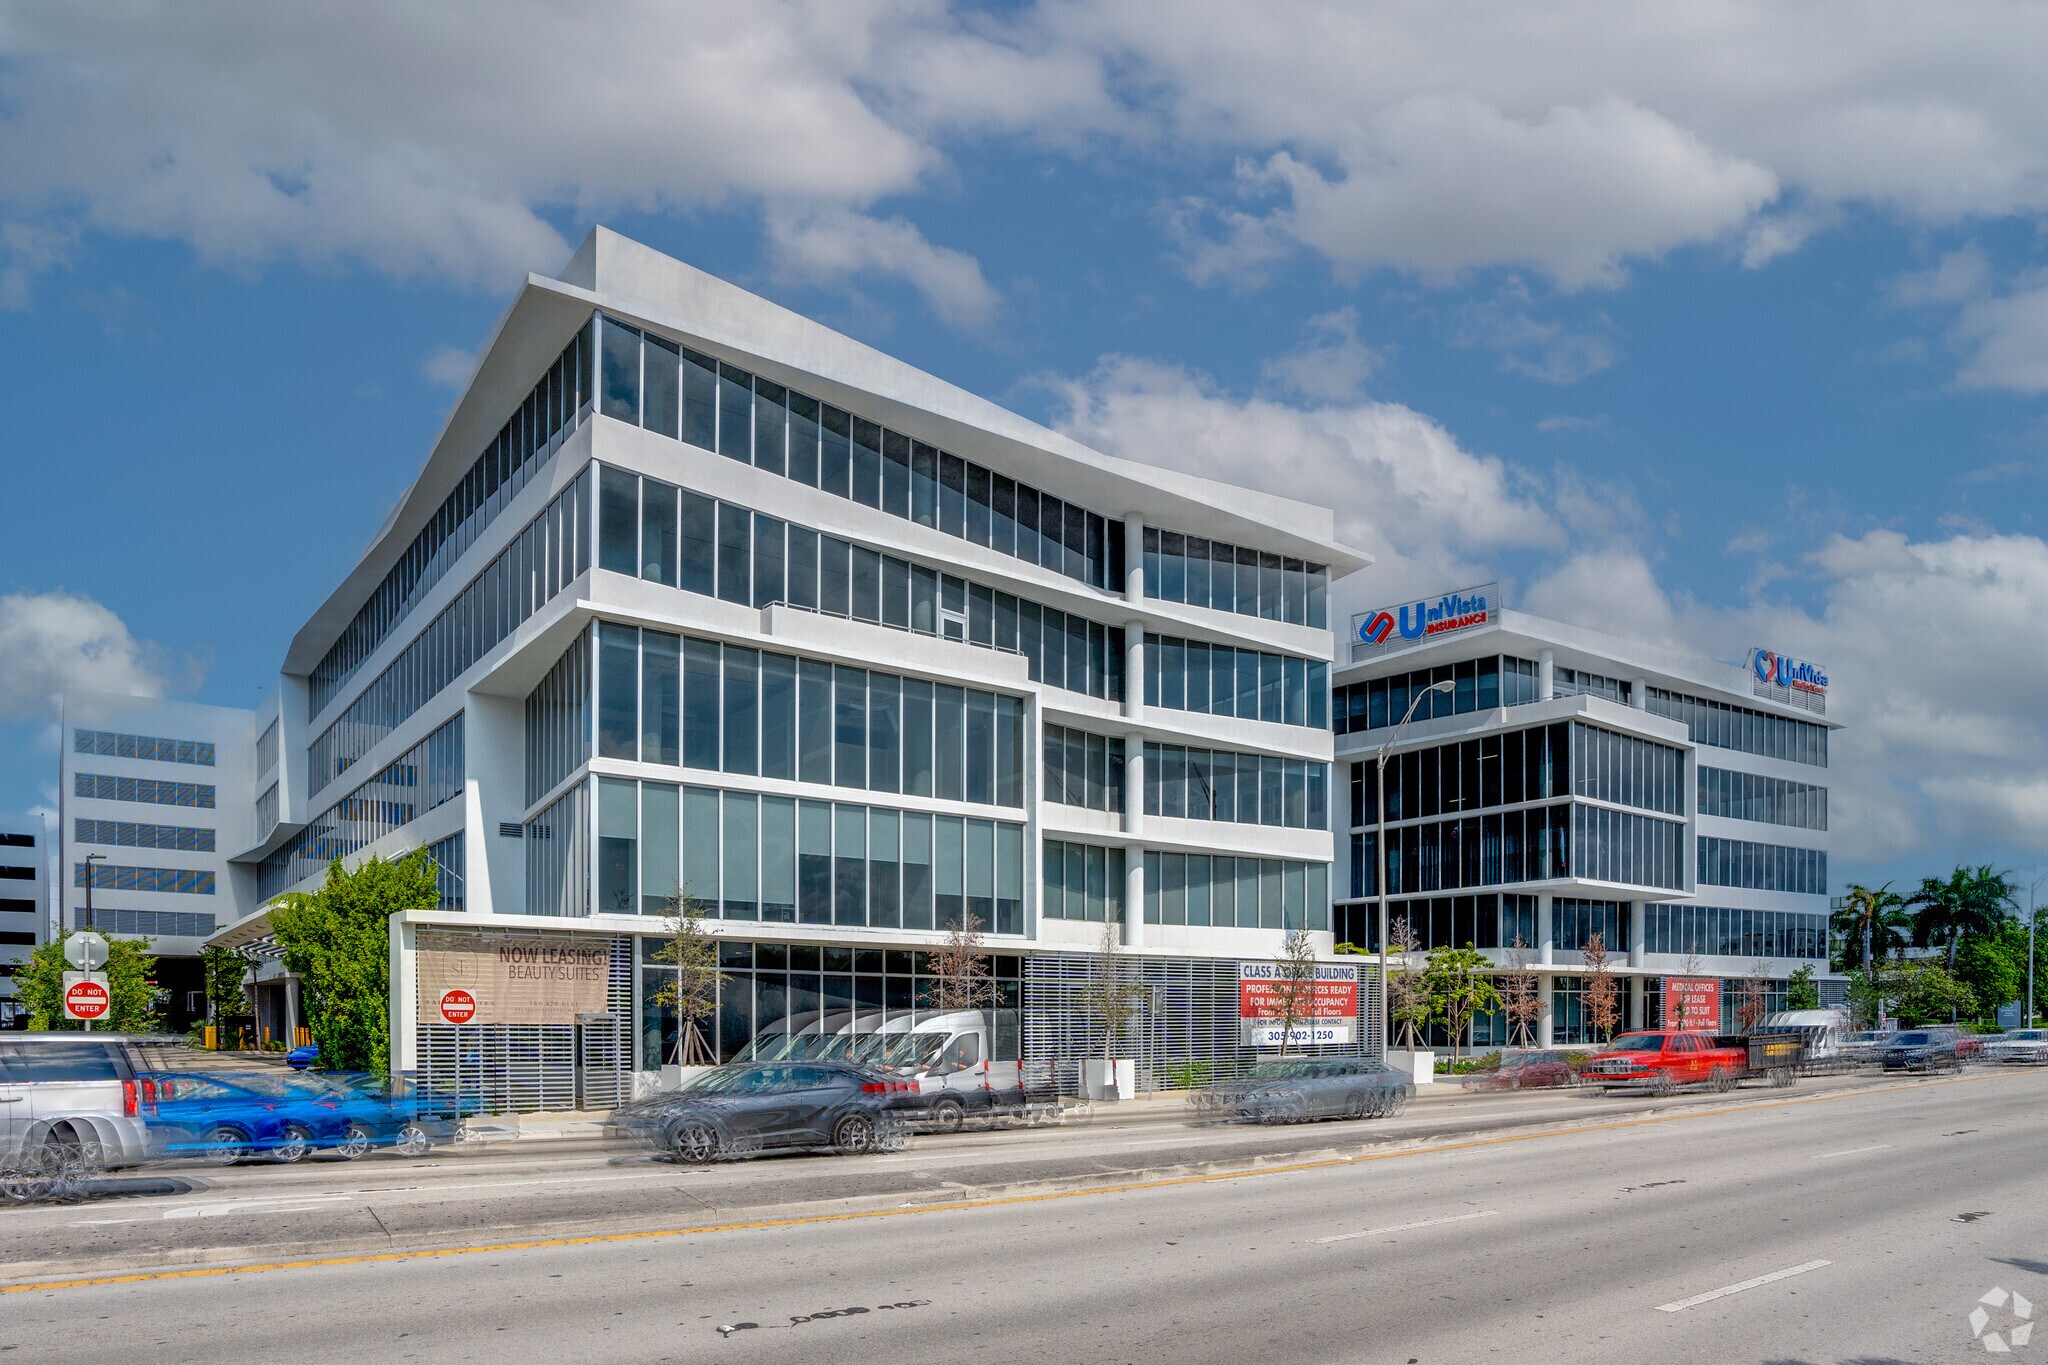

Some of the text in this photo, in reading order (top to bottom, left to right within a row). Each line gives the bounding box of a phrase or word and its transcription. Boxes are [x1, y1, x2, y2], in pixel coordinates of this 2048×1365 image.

[1399, 595, 1487, 640] UniVista
[1427, 612, 1487, 635] INSURANCE
[499, 946, 607, 966] NOW LEASING!
[508, 964, 600, 981] BEAUTY SUITES
[1243, 964, 1272, 978] CLASS
[1274, 966, 1281, 978] A
[1315, 967, 1355, 980] BUILDING
[71, 988, 83, 996] DO
[1330, 986, 1352, 995] READY
[1671, 982, 1714, 993] MEDICAL OFFICES
[1250, 997, 1265, 1006] FOR
[1691, 994, 1706, 1004] LEASE
[1257, 1008, 1275, 1016] From
[1323, 1007, 1342, 1016] Floors
[1268, 1030, 1334, 1041] 305-902-1250
